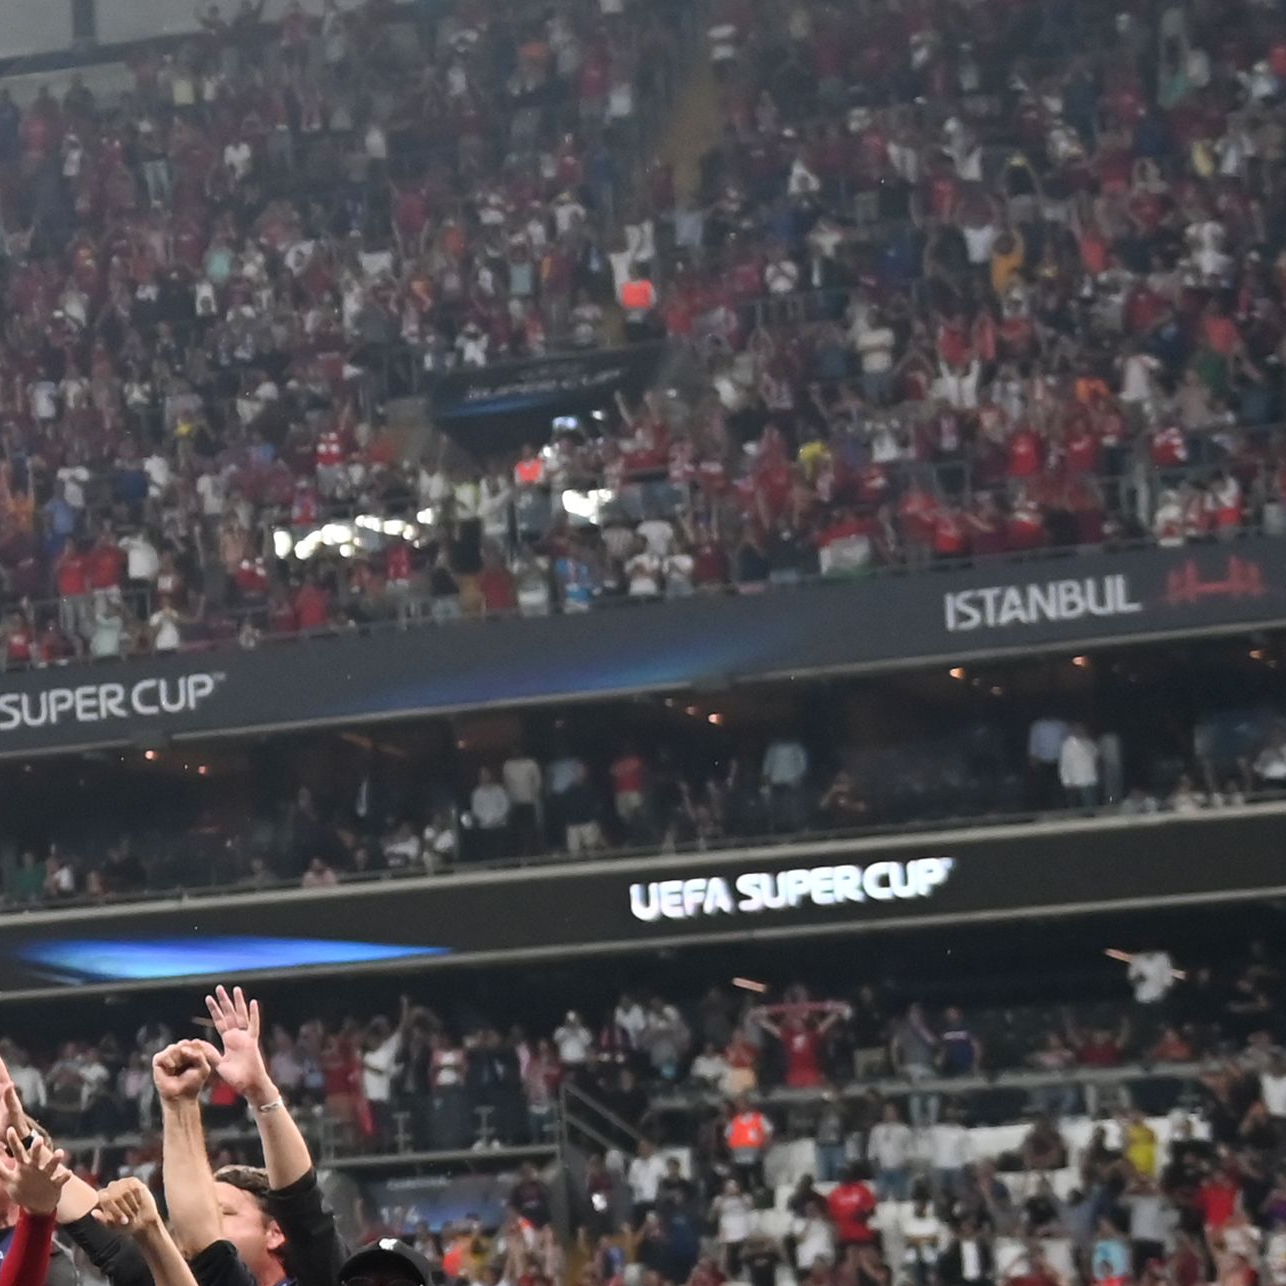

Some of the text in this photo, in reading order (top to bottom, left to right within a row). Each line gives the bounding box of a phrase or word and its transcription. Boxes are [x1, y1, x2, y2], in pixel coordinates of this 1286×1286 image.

[944, 574, 1143, 632] ISTANBUL
[629, 877, 732, 922] UEFA
[735, 865, 866, 912] SUPER
